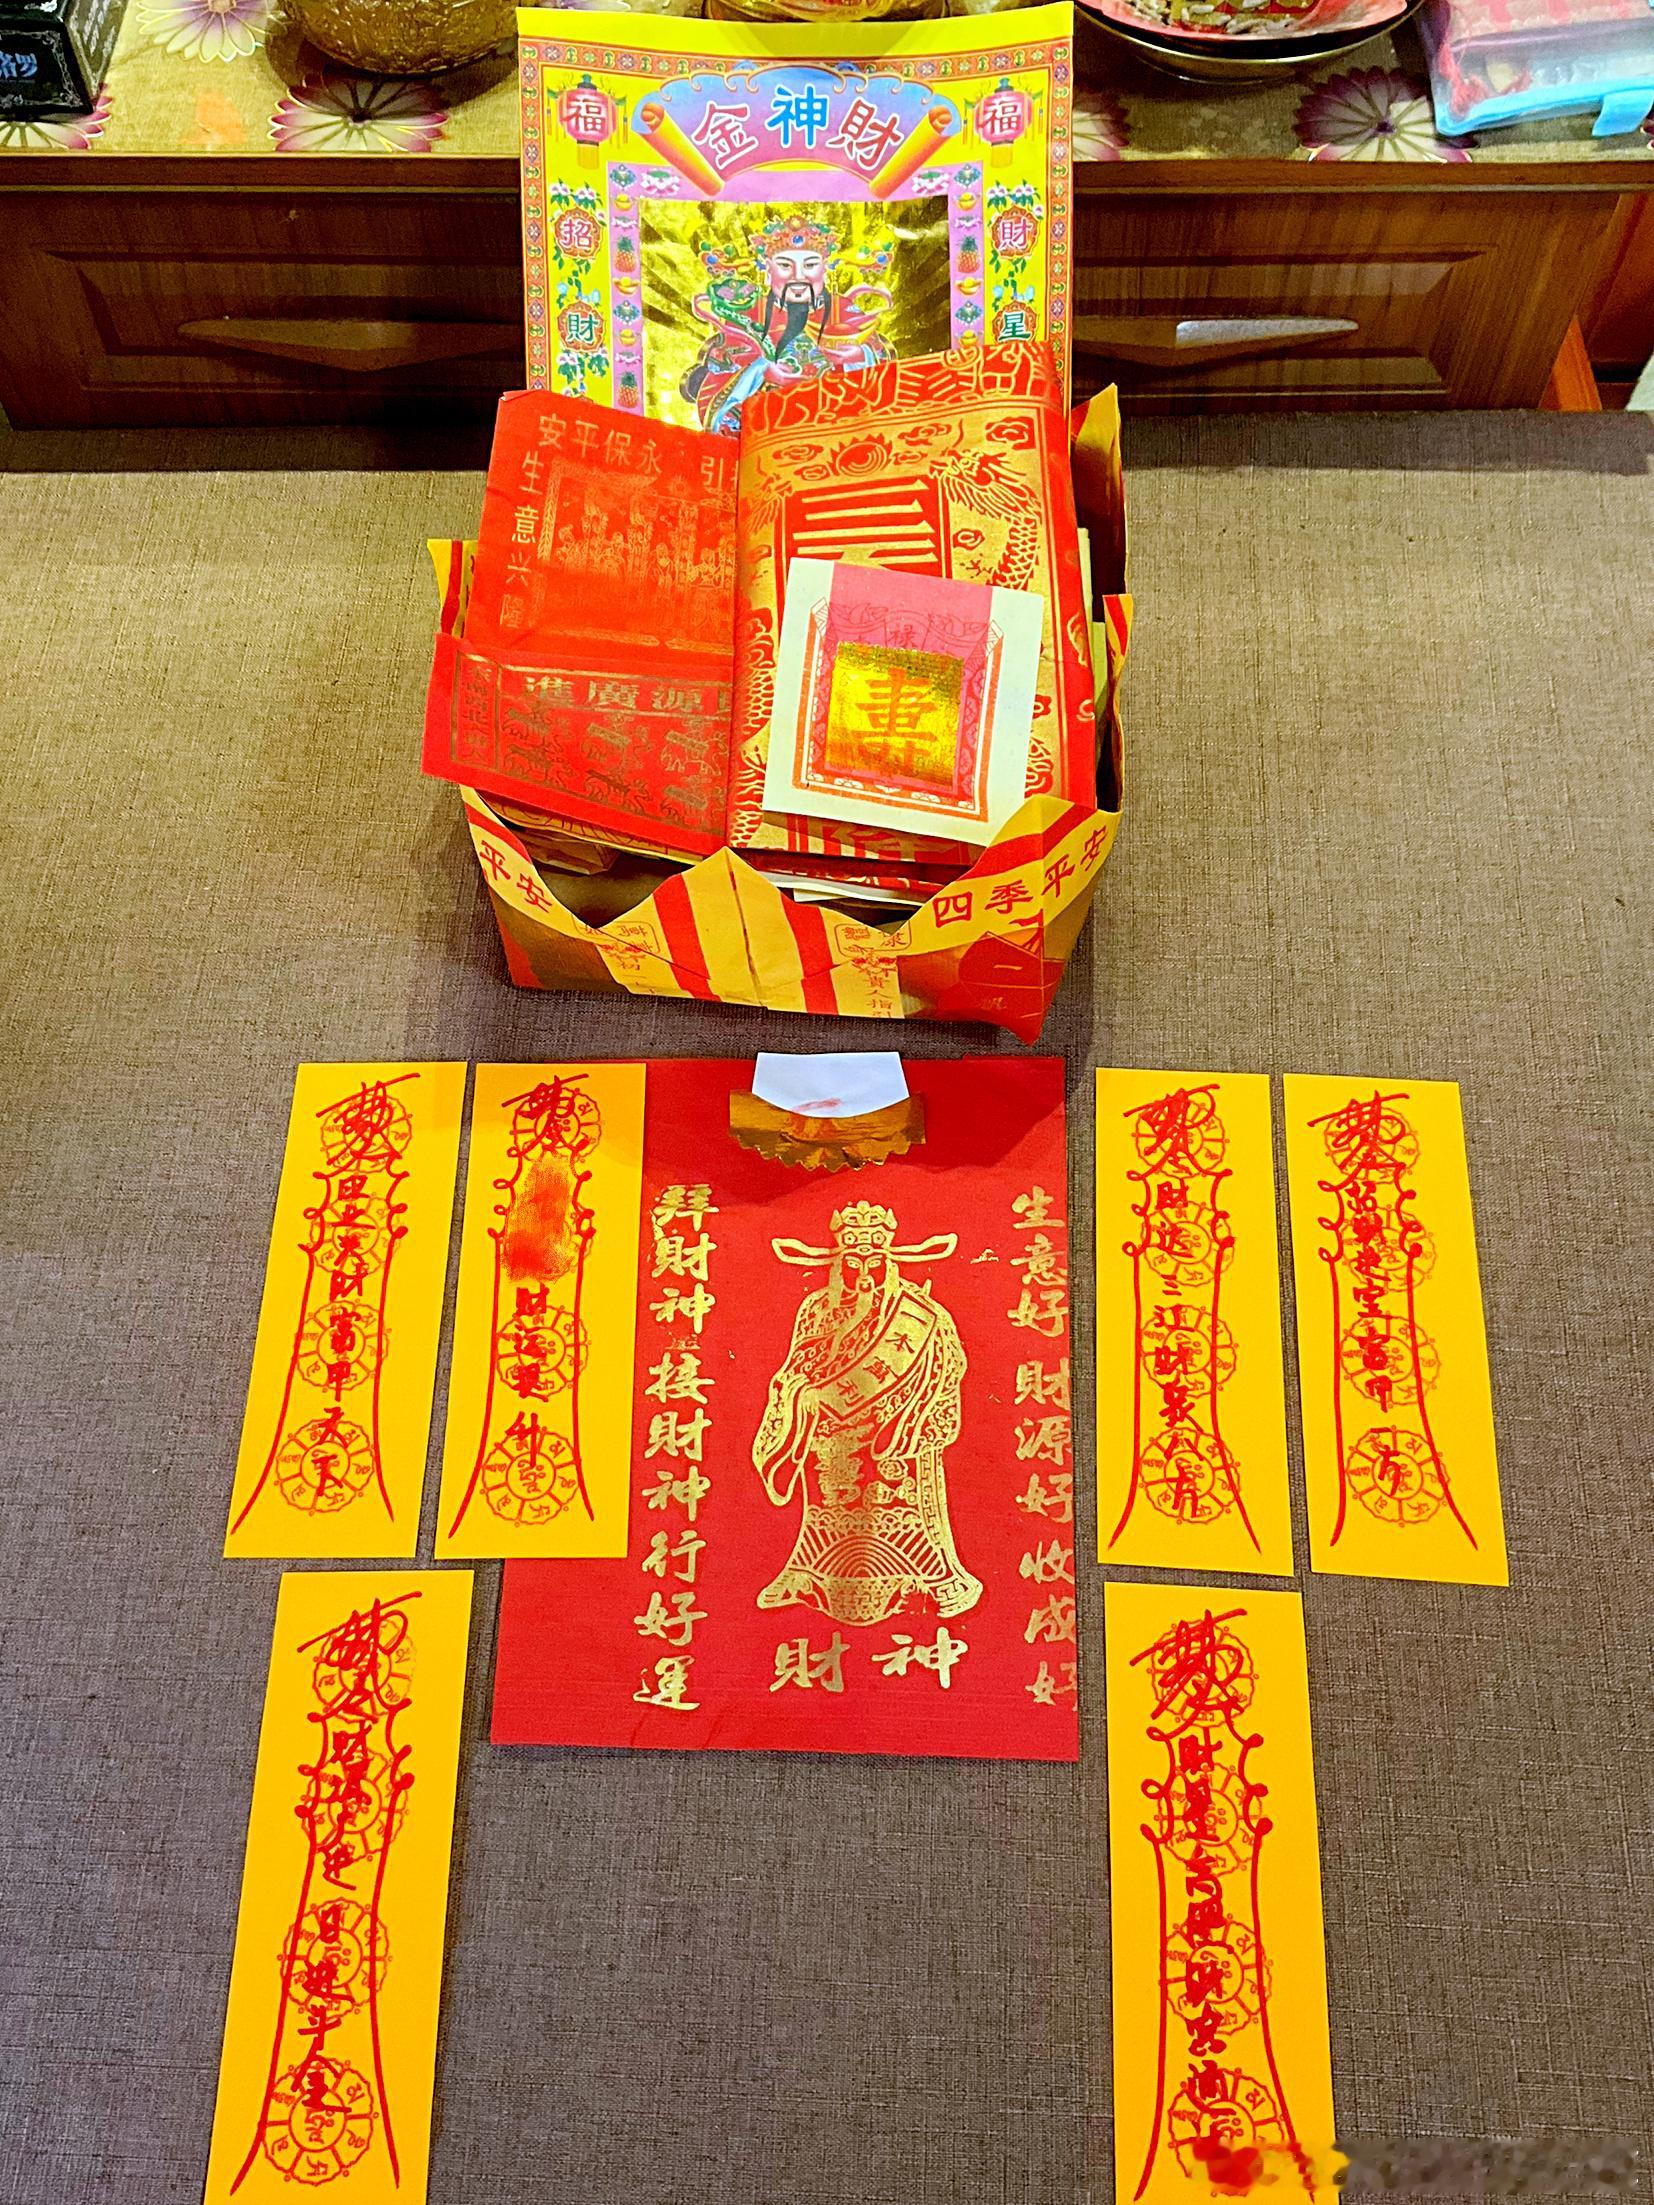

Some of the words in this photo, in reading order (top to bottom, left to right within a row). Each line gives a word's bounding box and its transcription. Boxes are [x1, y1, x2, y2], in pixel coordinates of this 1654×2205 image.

[568, 98, 606, 132] 福
[985, 98, 1022, 132] 福
[479, 840, 553, 913] 平安
[933, 825, 1107, 928] 四季平安
[769, 1626, 968, 1692] 財神
